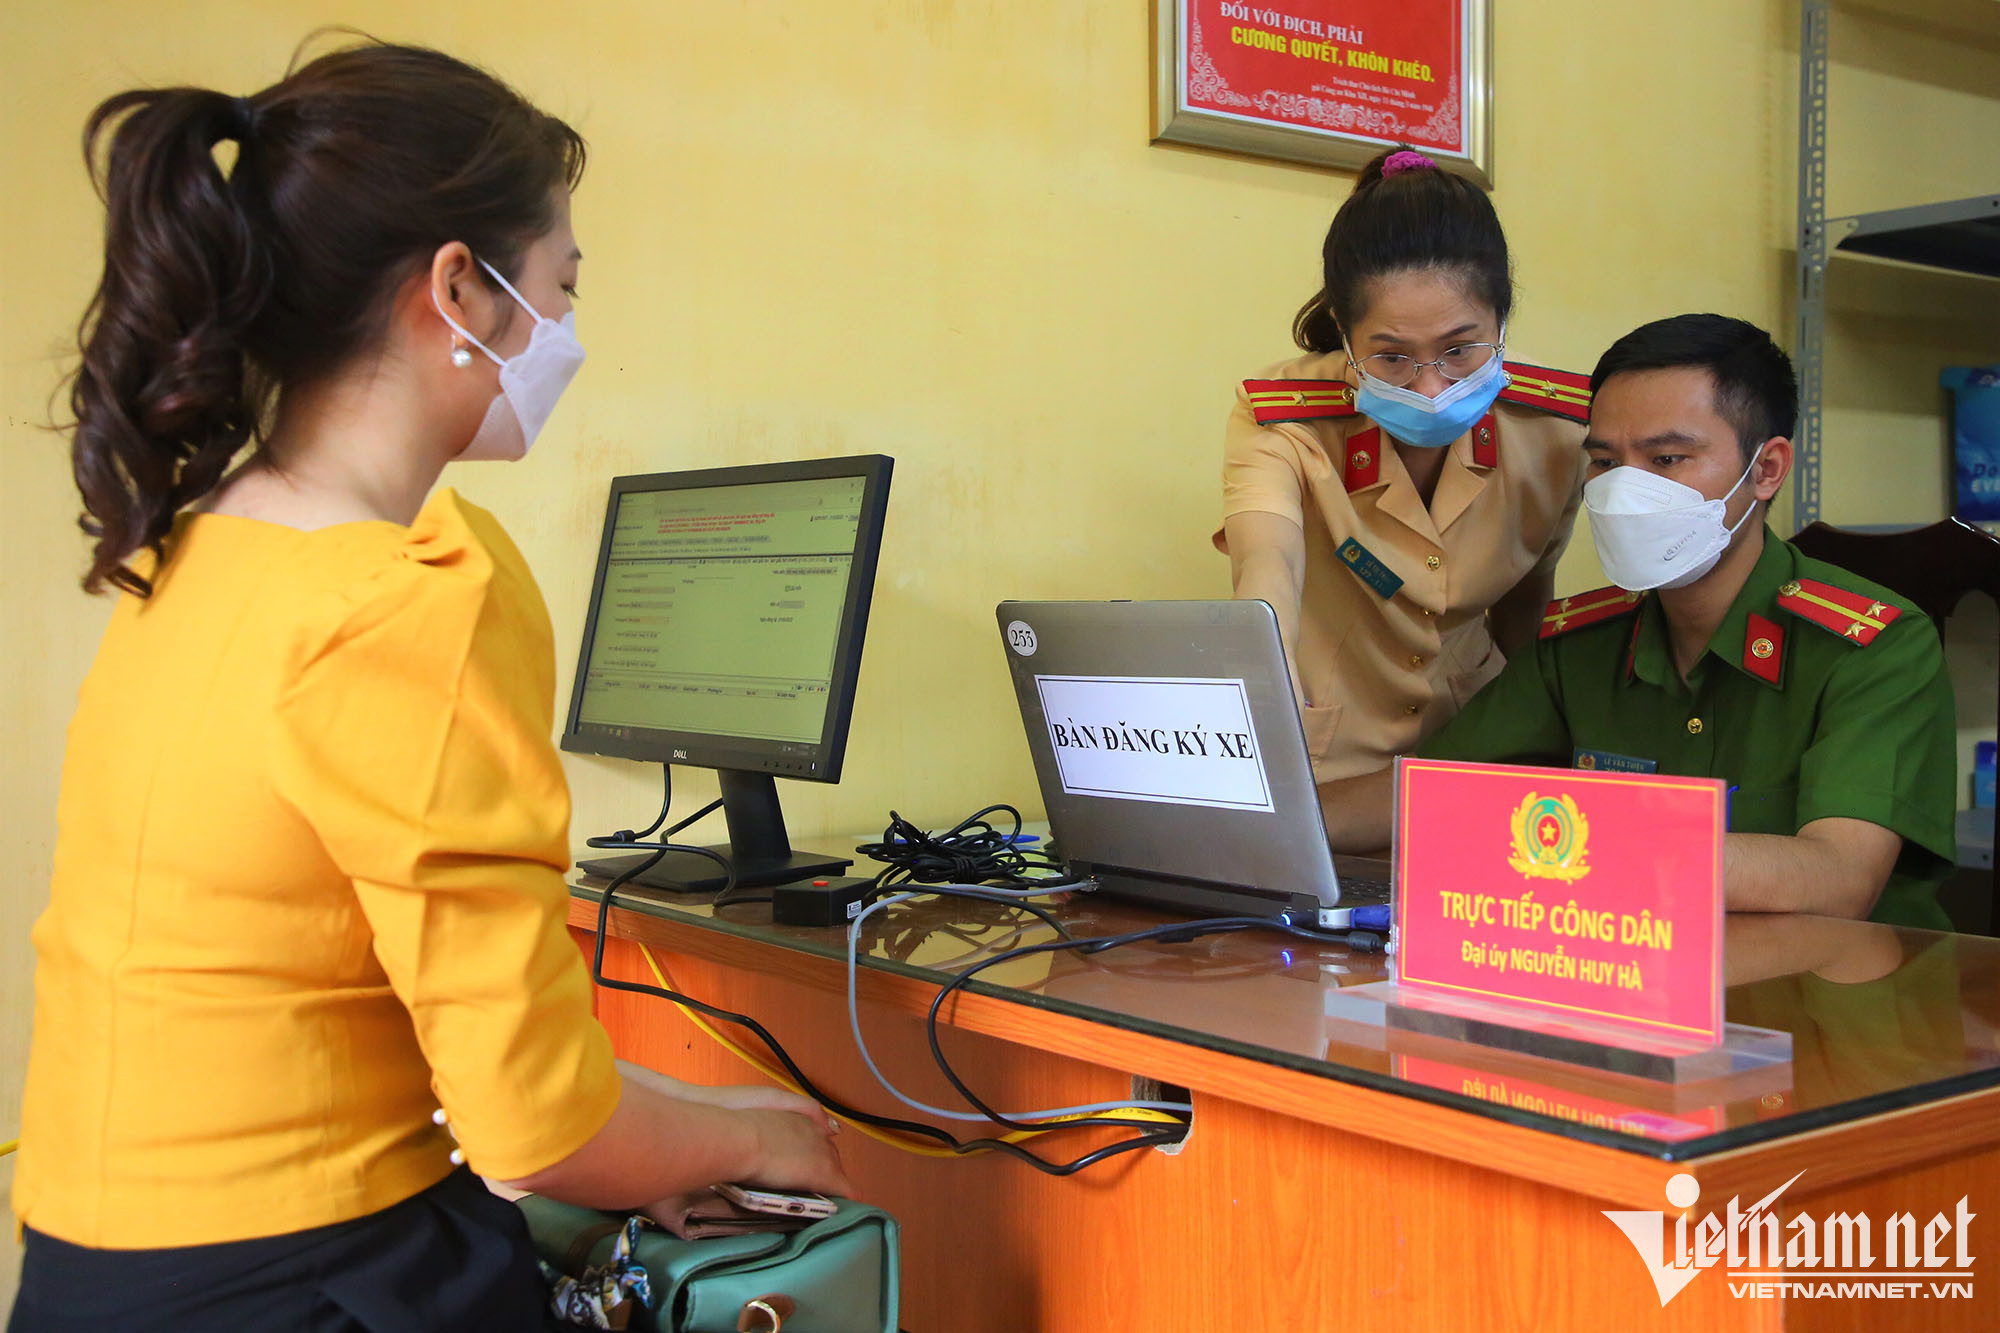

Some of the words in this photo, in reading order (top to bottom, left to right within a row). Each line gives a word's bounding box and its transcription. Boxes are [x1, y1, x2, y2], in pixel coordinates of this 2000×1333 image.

[1220, 0, 1249, 21] ĐỐI
[1252, 8, 1281, 28] VỚI
[1284, 15, 1325, 39] ĐỊCH,
[1327, 24, 1363, 45] PHẢI
[1231, 26, 1287, 53] CƯƠNG
[1291, 40, 1343, 67] QUYẾT,
[1347, 50, 1389, 74] KHÔN
[1392, 59, 1436, 83] KHÉO.
[1011, 629, 1034, 648] 253
[673, 749, 687, 760] DELL
[1052, 717, 1099, 749] BÀN
[1101, 720, 1169, 755] ĐĂNG
[1173, 723, 1208, 756] KÝ
[1215, 732, 1254, 759] XE
[1439, 890, 1496, 929] TRỰC
[1499, 890, 1545, 931] TIẾP
[1549, 899, 1615, 943] CÔNG
[1621, 908, 1672, 952] DÂN
[1462, 940, 1486, 969] Đại
[1489, 943, 1508, 974] úy
[1510, 945, 1576, 979] NGUYỄN
[1579, 957, 1615, 986] HUY
[1617, 960, 1643, 991] HÀ
